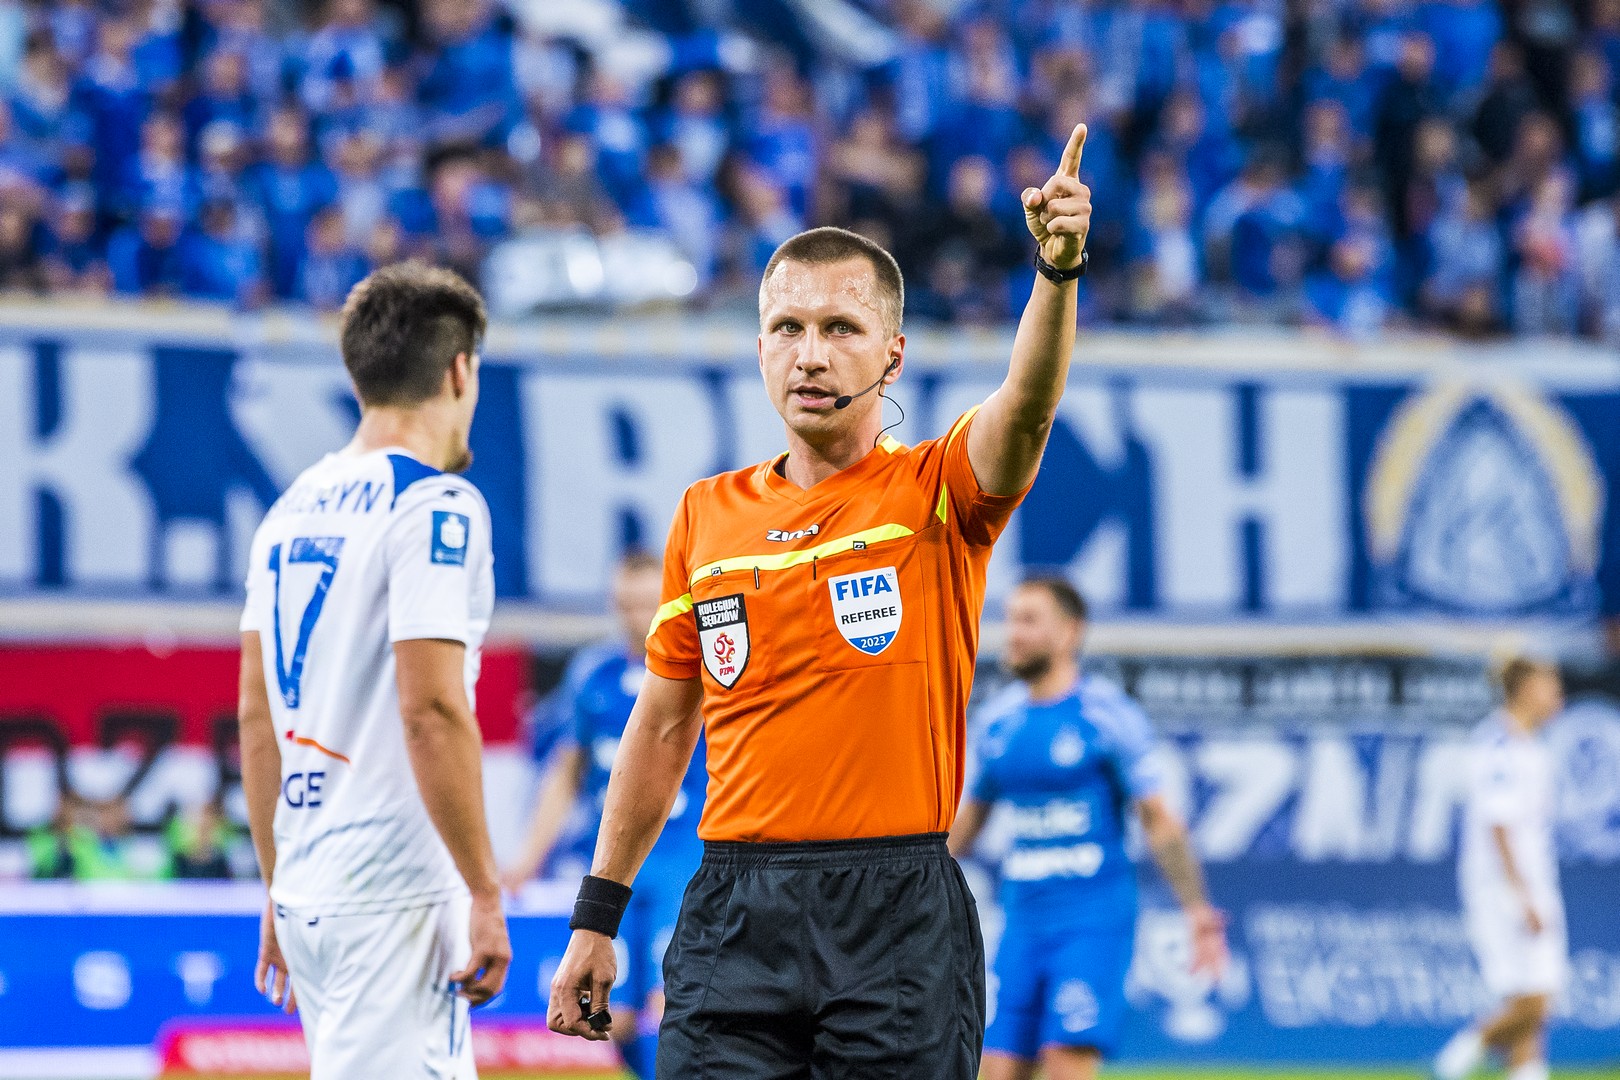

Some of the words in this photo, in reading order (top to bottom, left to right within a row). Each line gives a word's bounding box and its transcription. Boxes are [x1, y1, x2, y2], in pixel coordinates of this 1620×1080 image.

[835, 574, 893, 601] FIFA
[697, 596, 740, 616] KOLEGIUM
[841, 606, 897, 625] REFEREE
[267, 537, 347, 709] 17
[701, 609, 739, 628] SĘDZIÓW
[860, 635, 887, 649] 2023
[719, 665, 736, 677] PZPN
